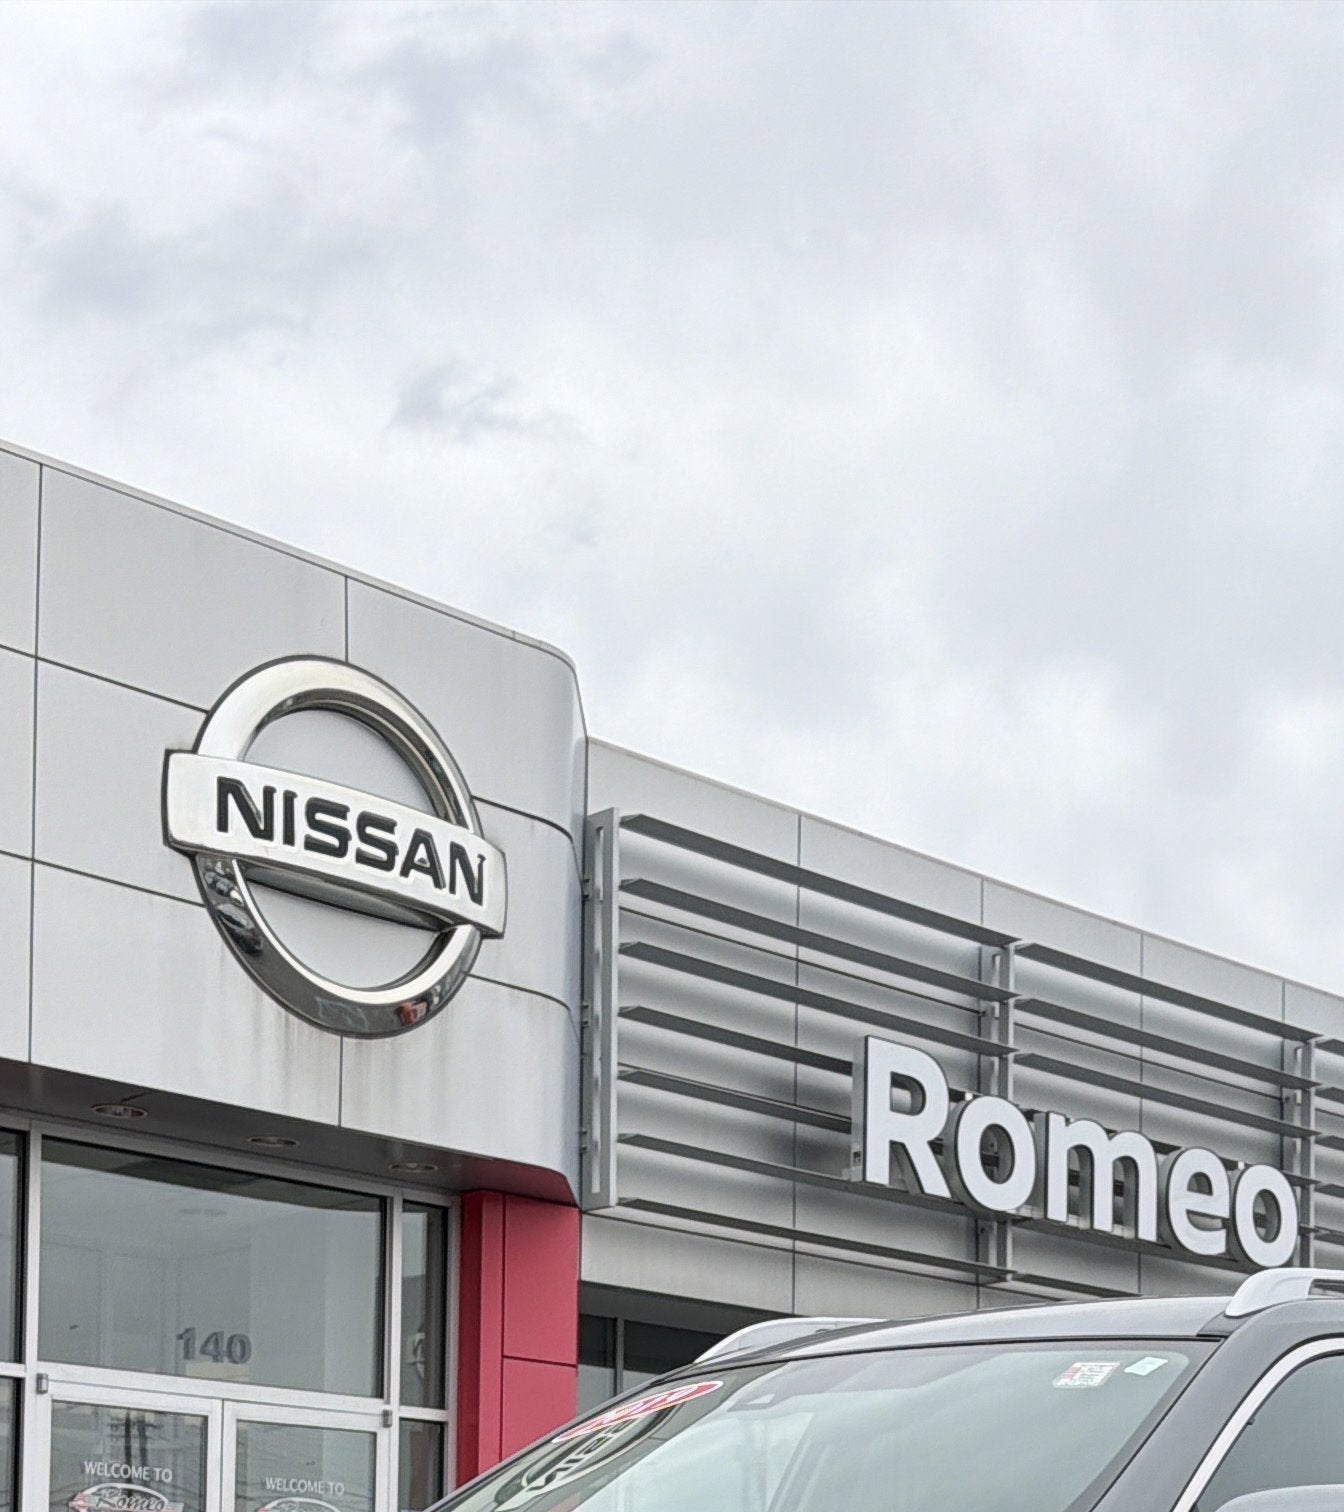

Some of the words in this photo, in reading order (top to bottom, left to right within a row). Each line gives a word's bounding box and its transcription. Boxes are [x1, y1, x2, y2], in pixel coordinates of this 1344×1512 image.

[216, 776, 487, 906] NISSAN
[862, 1035, 1298, 1268] Romeo
[176, 1327, 252, 1365] 140
[85, 1461, 150, 1480] WELCOME
[155, 1467, 173, 1483] TO
[265, 1477, 325, 1495] WELCOME
[328, 1481, 345, 1496] TO
[96, 1486, 166, 1512] Romeo
